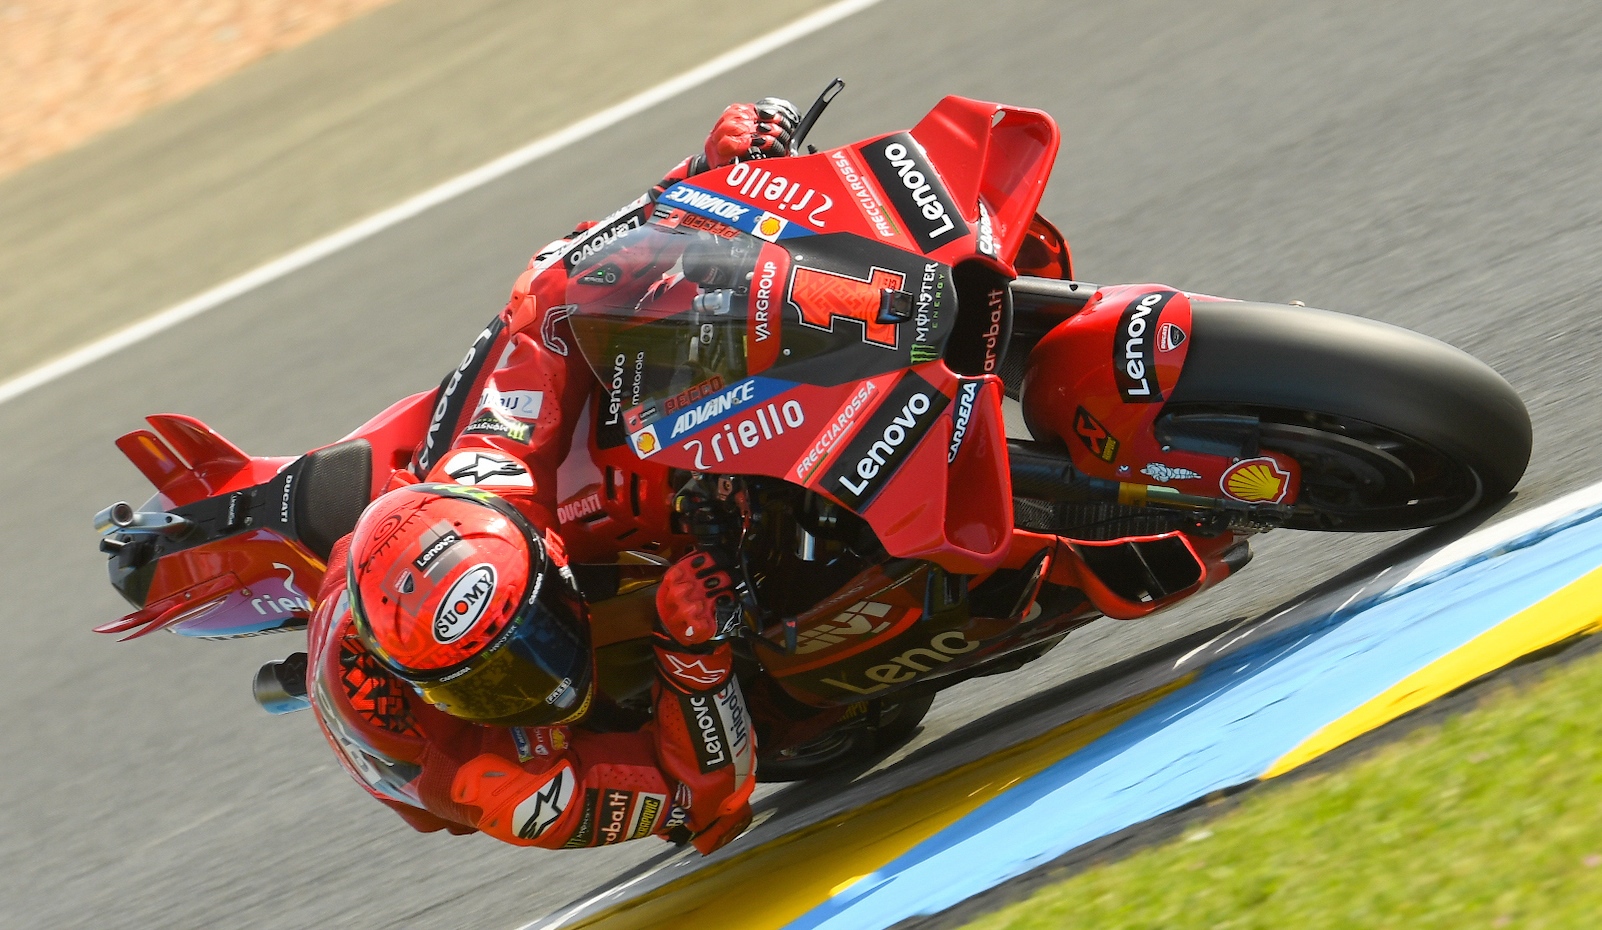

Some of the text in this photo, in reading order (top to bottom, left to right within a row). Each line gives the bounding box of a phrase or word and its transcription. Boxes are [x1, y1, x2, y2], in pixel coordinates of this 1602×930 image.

[666, 185, 751, 222] ADVANCE
[725, 163, 815, 212] riello
[830, 151, 895, 238] FRECCIAROSSA
[884, 142, 956, 239] Lenovo
[569, 215, 641, 267] Lenovo
[755, 261, 777, 342] VARGROUP
[787, 265, 907, 350] 1
[915, 262, 939, 342] MONSTER
[932, 273, 945, 329] ENERGY
[983, 289, 1004, 372] aruba.it
[1125, 293, 1162, 396] Lenovo
[605, 353, 625, 426] Lenovo
[632, 351, 645, 406] motorola
[670, 380, 755, 439] ADVANCE
[710, 400, 805, 463] riello
[796, 380, 876, 479] FRECCIAROSSA
[838, 392, 931, 497] Lenovo
[948, 382, 977, 464] CARRERA
[281, 474, 293, 523] DUCATI
[557, 493, 602, 525] DUCATI
[417, 535, 456, 568] Lenovo
[435, 573, 494, 635] SUOMY
[690, 696, 725, 767] Lenovo
[602, 791, 629, 845] uba.it
